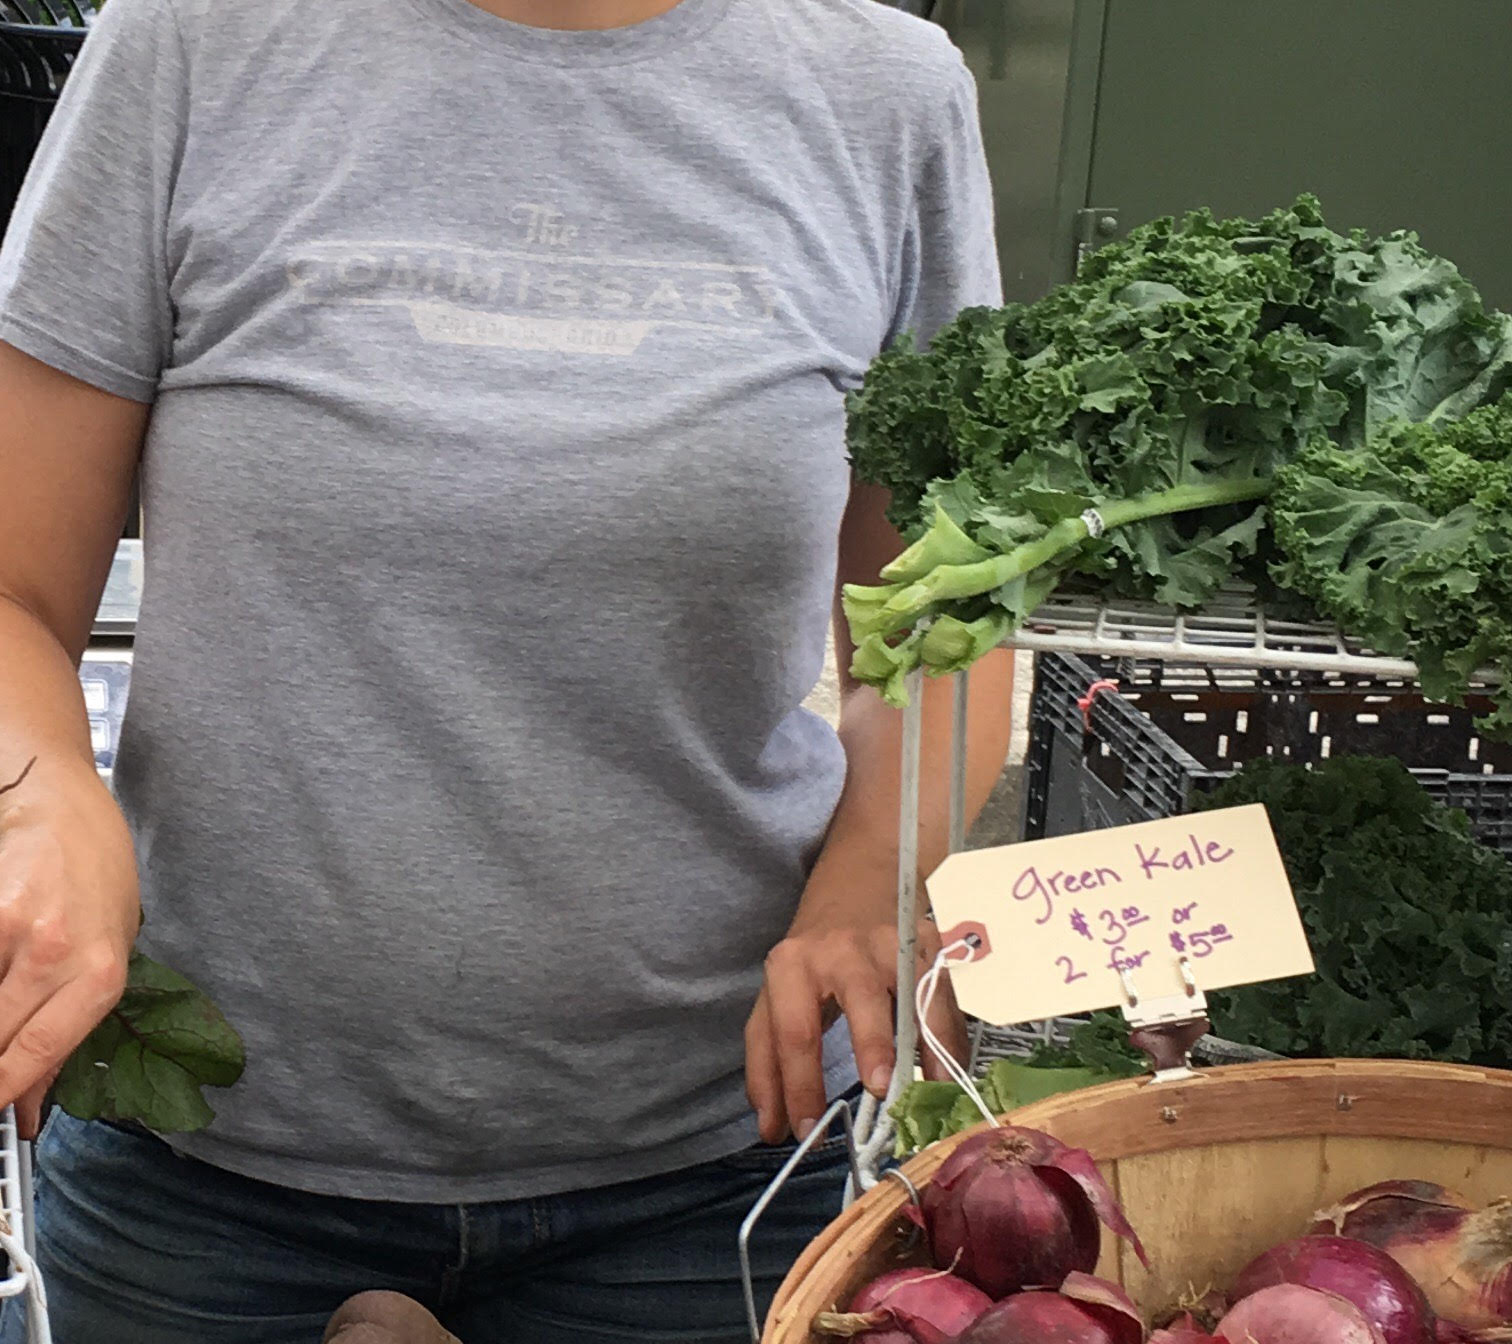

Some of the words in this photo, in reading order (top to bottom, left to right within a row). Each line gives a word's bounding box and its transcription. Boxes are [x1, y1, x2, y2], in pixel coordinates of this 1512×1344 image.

[1134, 834, 1235, 880] Kale
[1171, 901, 1199, 925] or
[1054, 955, 1088, 985] 2
[1106, 946, 1150, 971] for
